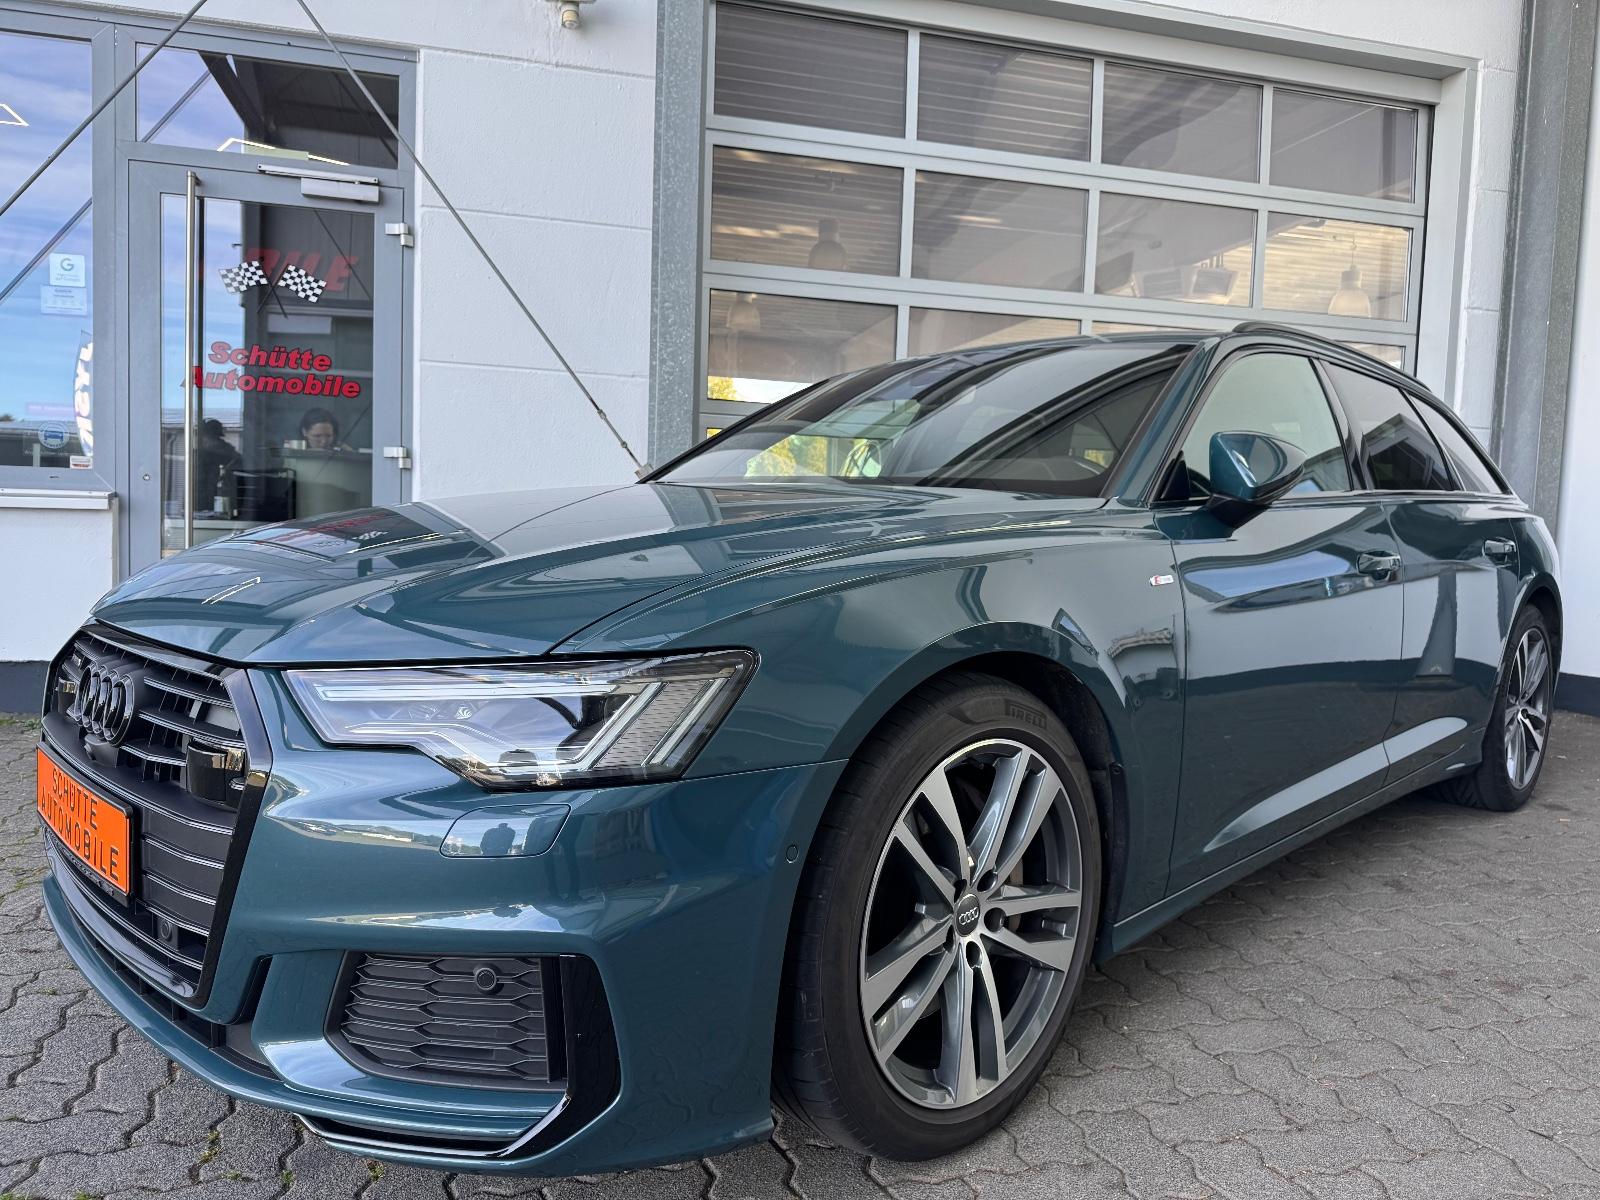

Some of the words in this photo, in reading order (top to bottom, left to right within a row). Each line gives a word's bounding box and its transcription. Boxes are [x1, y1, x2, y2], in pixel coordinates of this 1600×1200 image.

[208, 341, 332, 371] Schütte
[181, 366, 361, 398] Automobile
[41, 786, 119, 881] AUTOMOBILE
